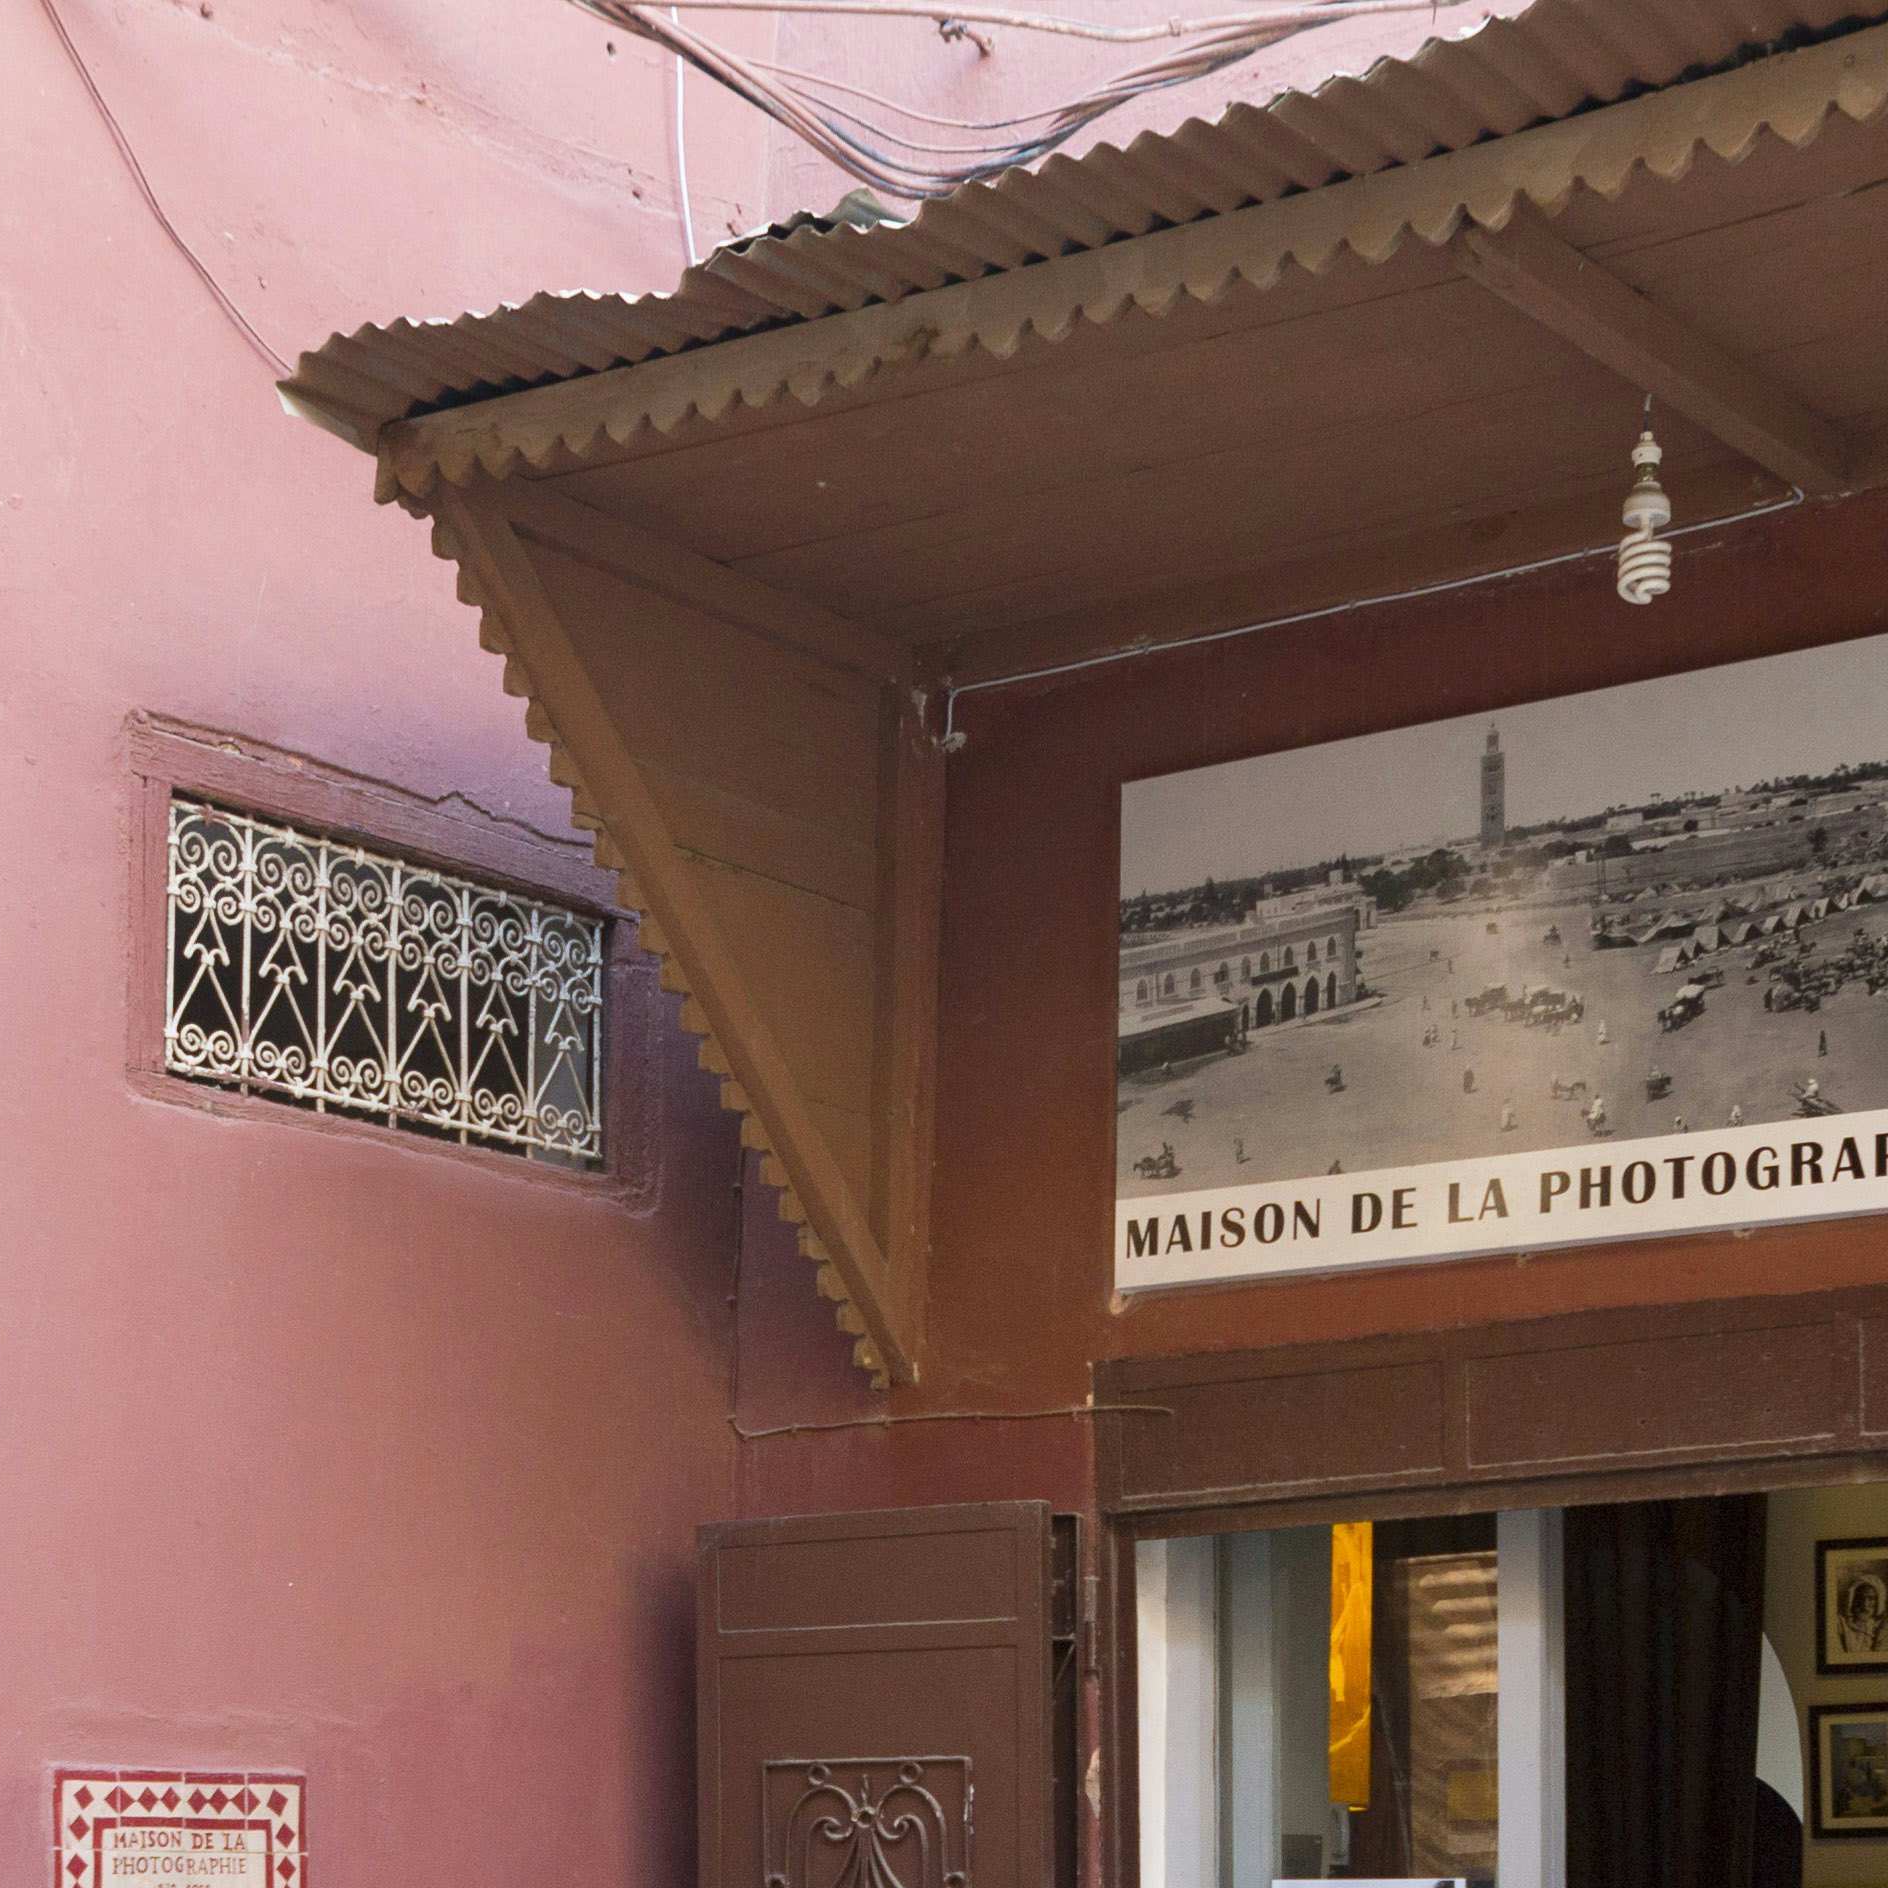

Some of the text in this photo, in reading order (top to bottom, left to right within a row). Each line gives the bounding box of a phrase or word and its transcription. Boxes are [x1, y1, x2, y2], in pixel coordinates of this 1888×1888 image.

[1124, 1197, 1322, 1260] MAISON
[1350, 1186, 1419, 1236] DE
[1447, 1177, 1510, 1224] LA
[113, 1830, 183, 1849] MAISON
[191, 1832, 214, 1850] DE
[112, 1856, 247, 1875] PHOTOGRAPHIE
